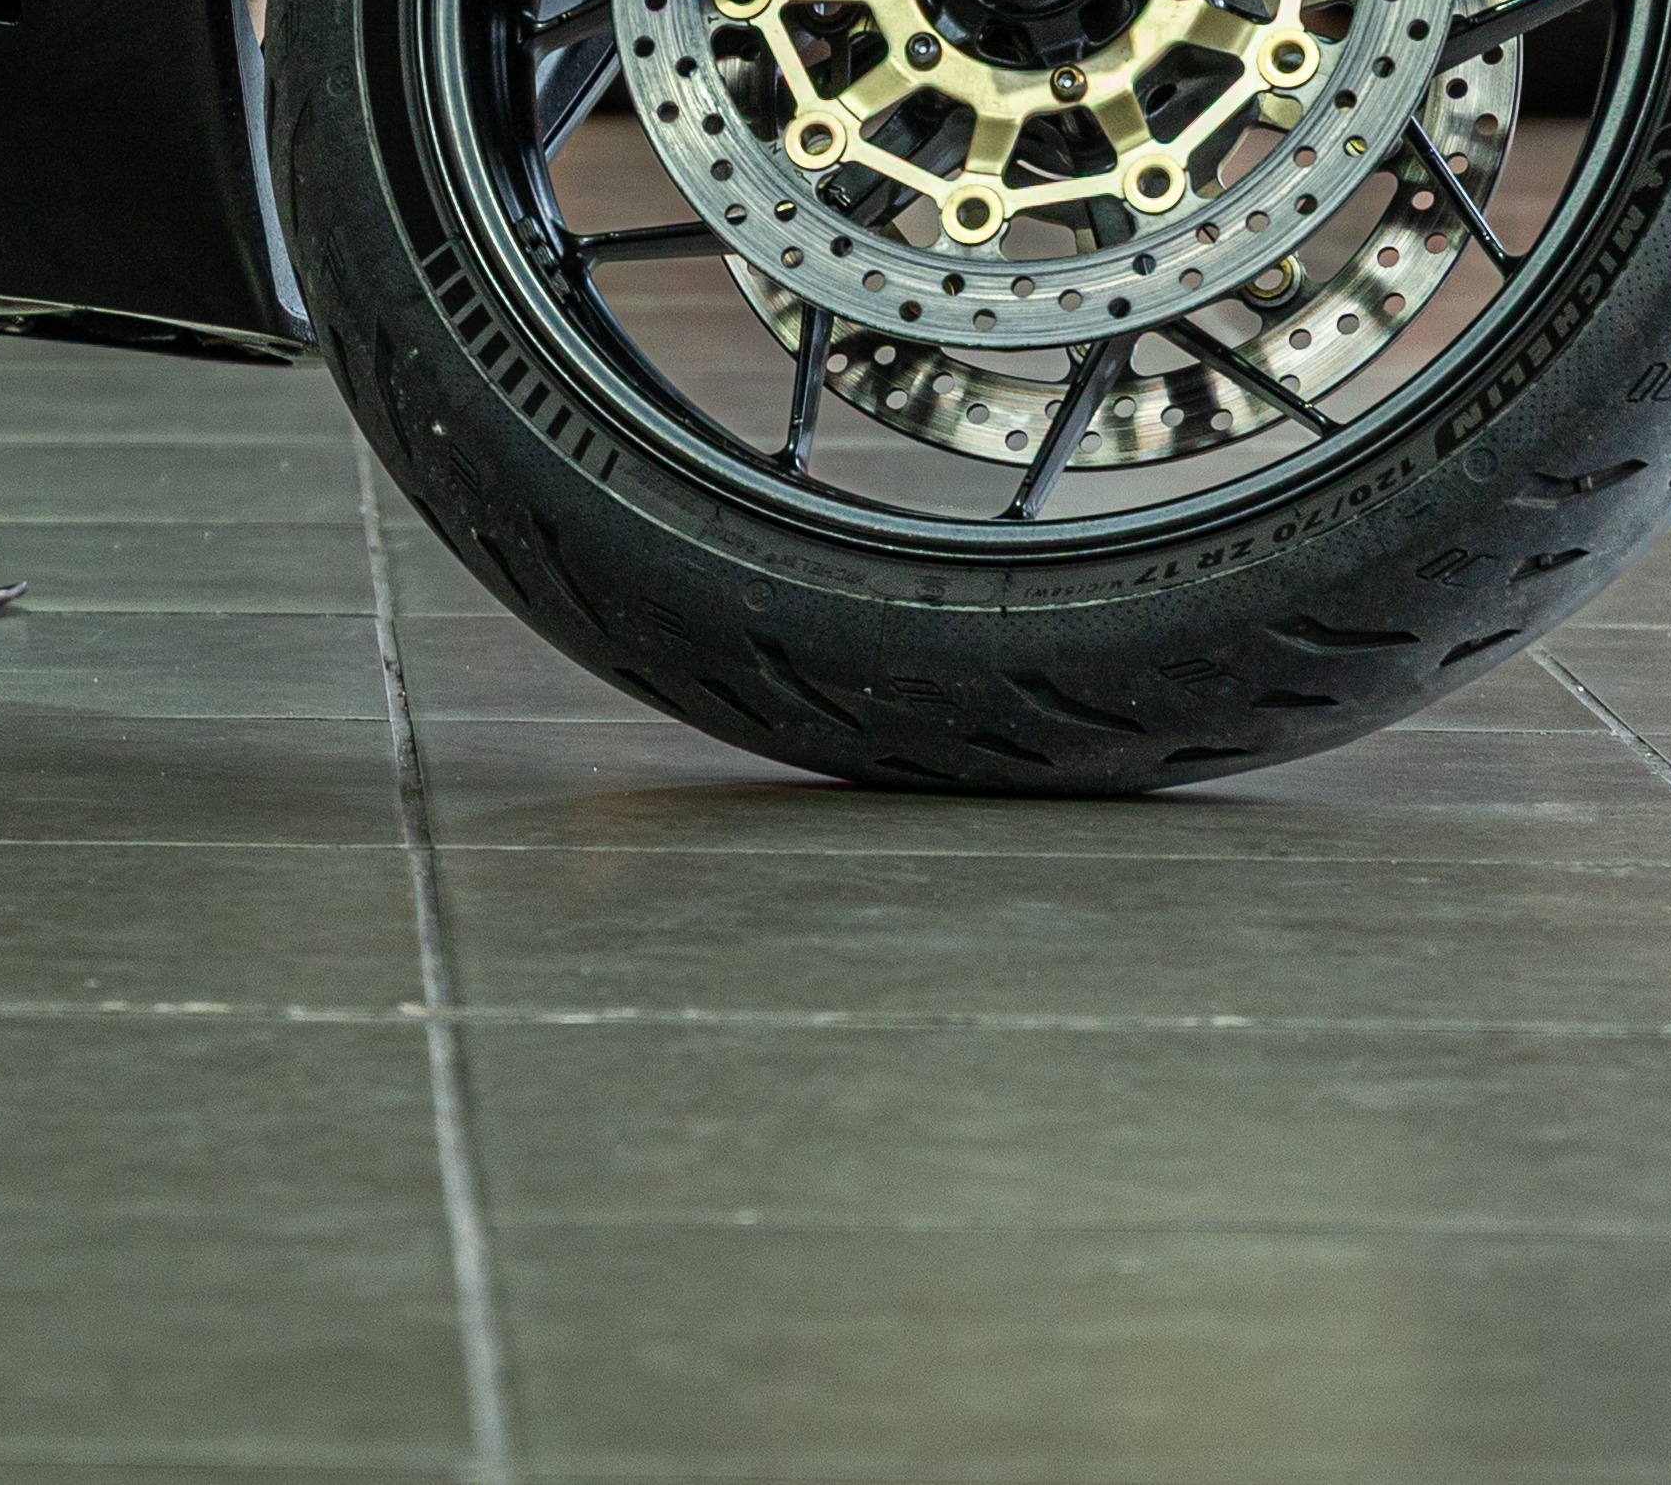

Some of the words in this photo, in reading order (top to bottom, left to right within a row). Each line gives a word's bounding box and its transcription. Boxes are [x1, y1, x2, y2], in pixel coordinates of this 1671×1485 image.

[1451, 203, 1647, 439] MICHELIN
[1272, 455, 1417, 544] 120/70
[1133, 560, 1181, 587] 17
[1196, 537, 1255, 570] ZR
